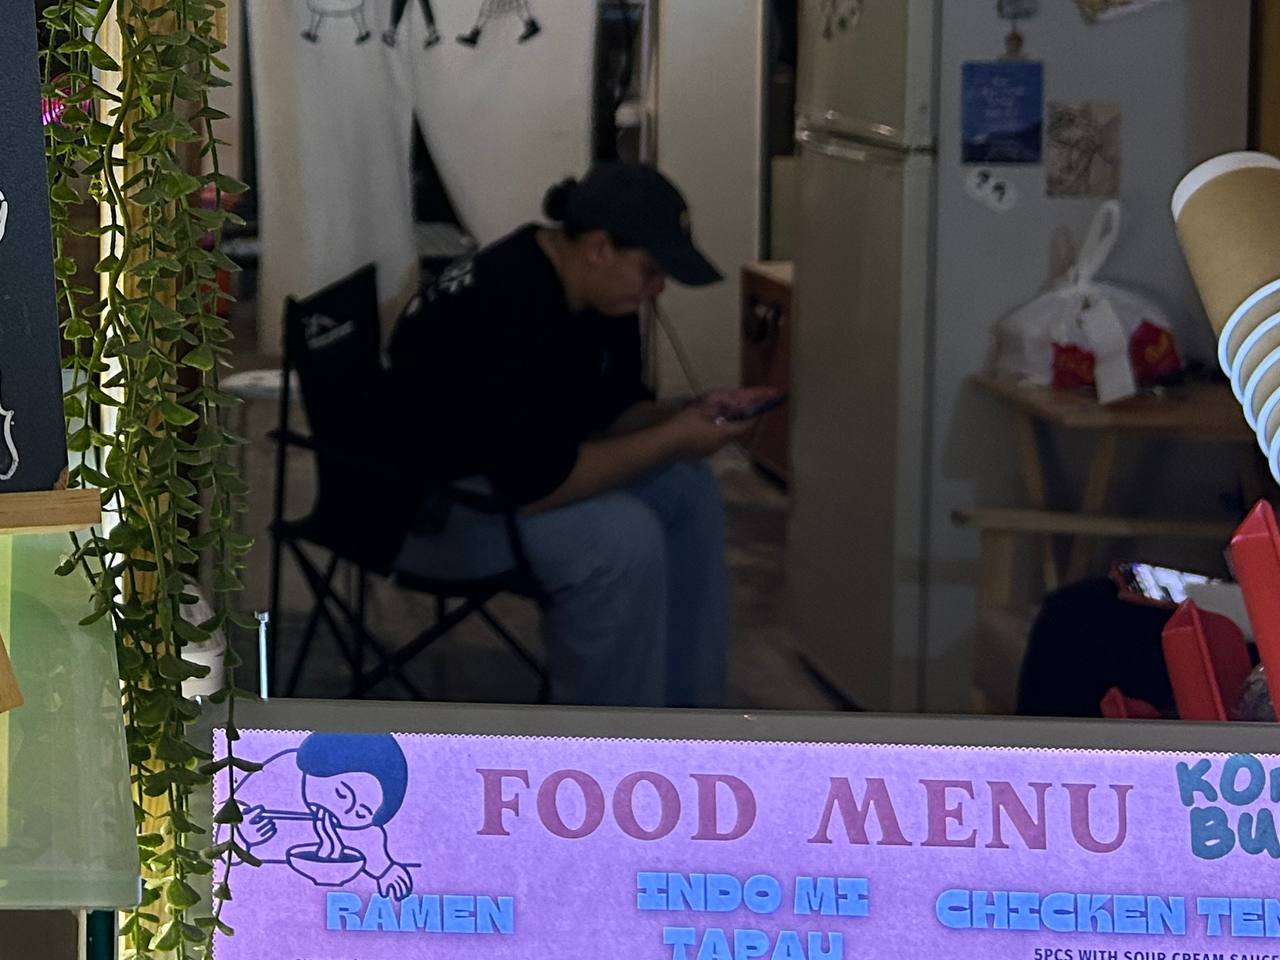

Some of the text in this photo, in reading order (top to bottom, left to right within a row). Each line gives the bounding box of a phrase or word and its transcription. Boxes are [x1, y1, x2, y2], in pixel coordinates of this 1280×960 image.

[476, 768, 1135, 854] FOOD MENU
[325, 891, 515, 935] RAMEN
[636, 871, 870, 918] INDO MI
[935, 889, 1187, 937] CHICKEN
[1033, 948, 1074, 960] 5PCS
[1077, 949, 1118, 960] WITH
